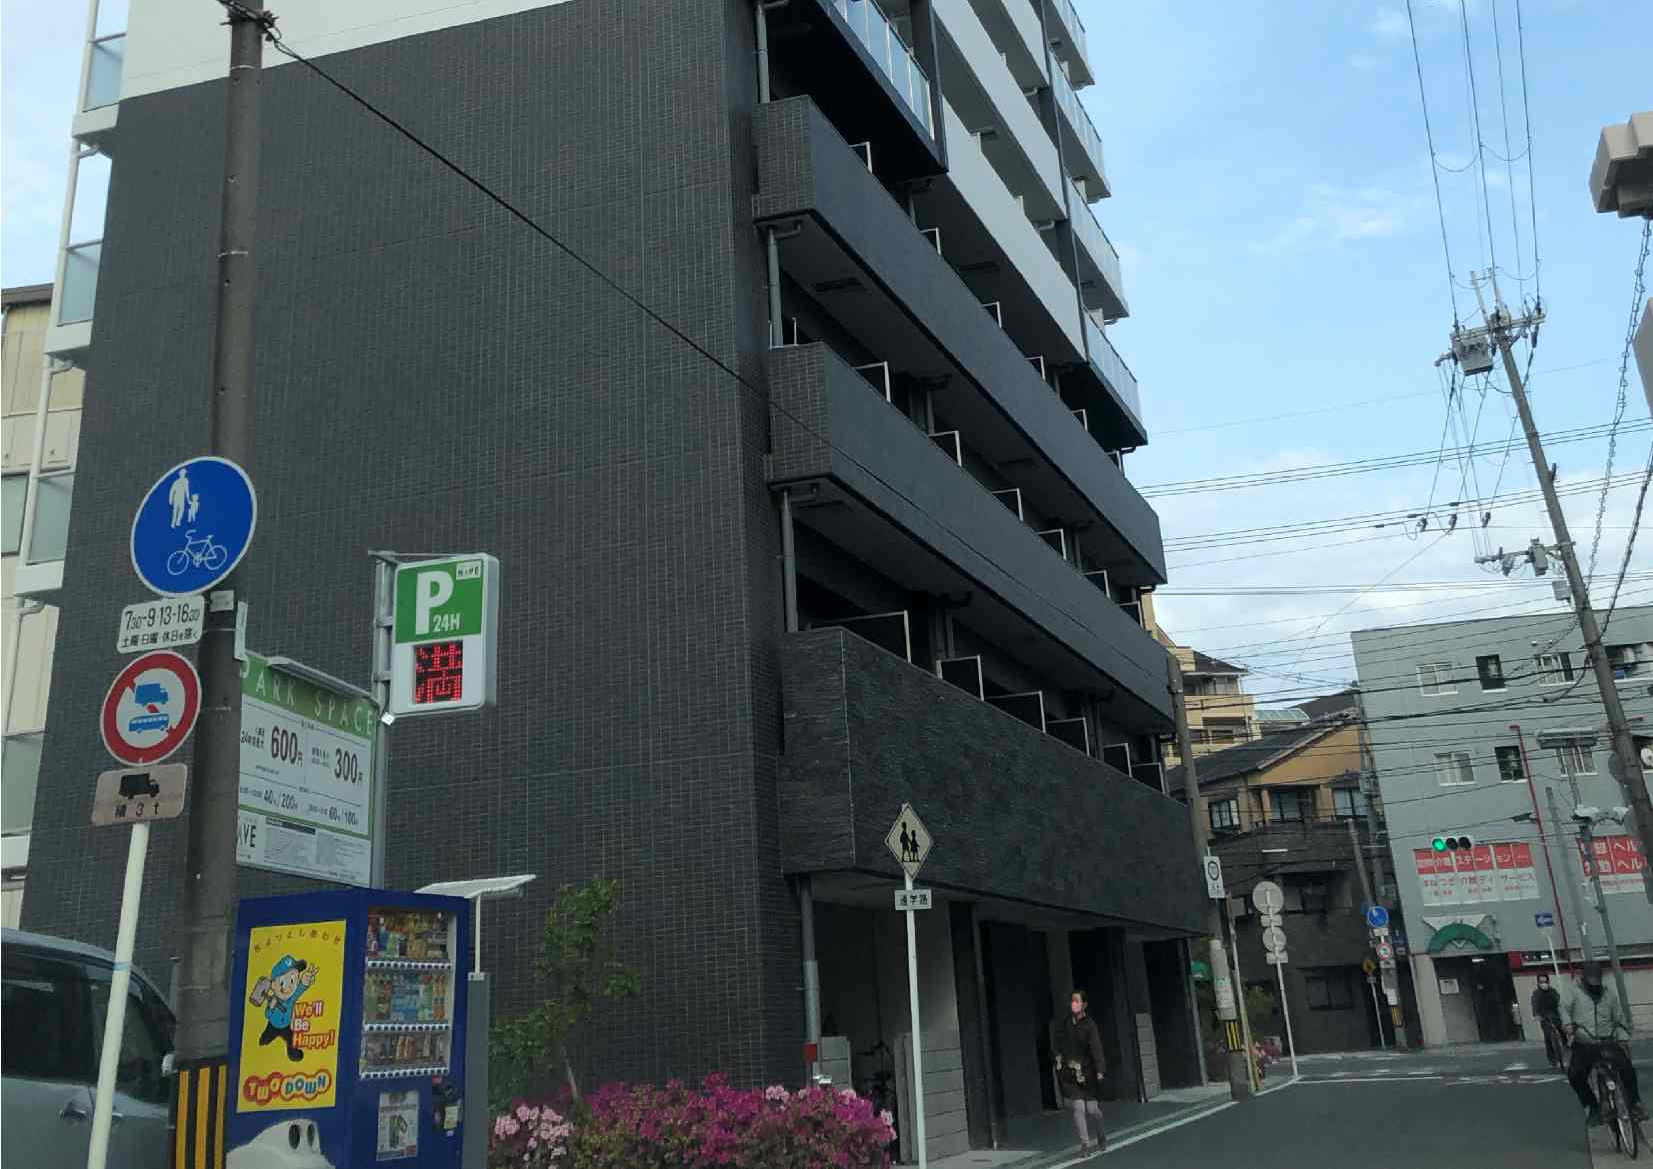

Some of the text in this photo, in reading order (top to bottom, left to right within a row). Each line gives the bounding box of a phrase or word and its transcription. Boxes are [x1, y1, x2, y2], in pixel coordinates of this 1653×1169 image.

[416, 571, 454, 635] P
[432, 613, 461, 632] 24H
[314, 691, 374, 736] SPACE
[295, 1000, 323, 1019] We'll
[294, 1018, 311, 1031] Be
[292, 1030, 336, 1049] Happy!
